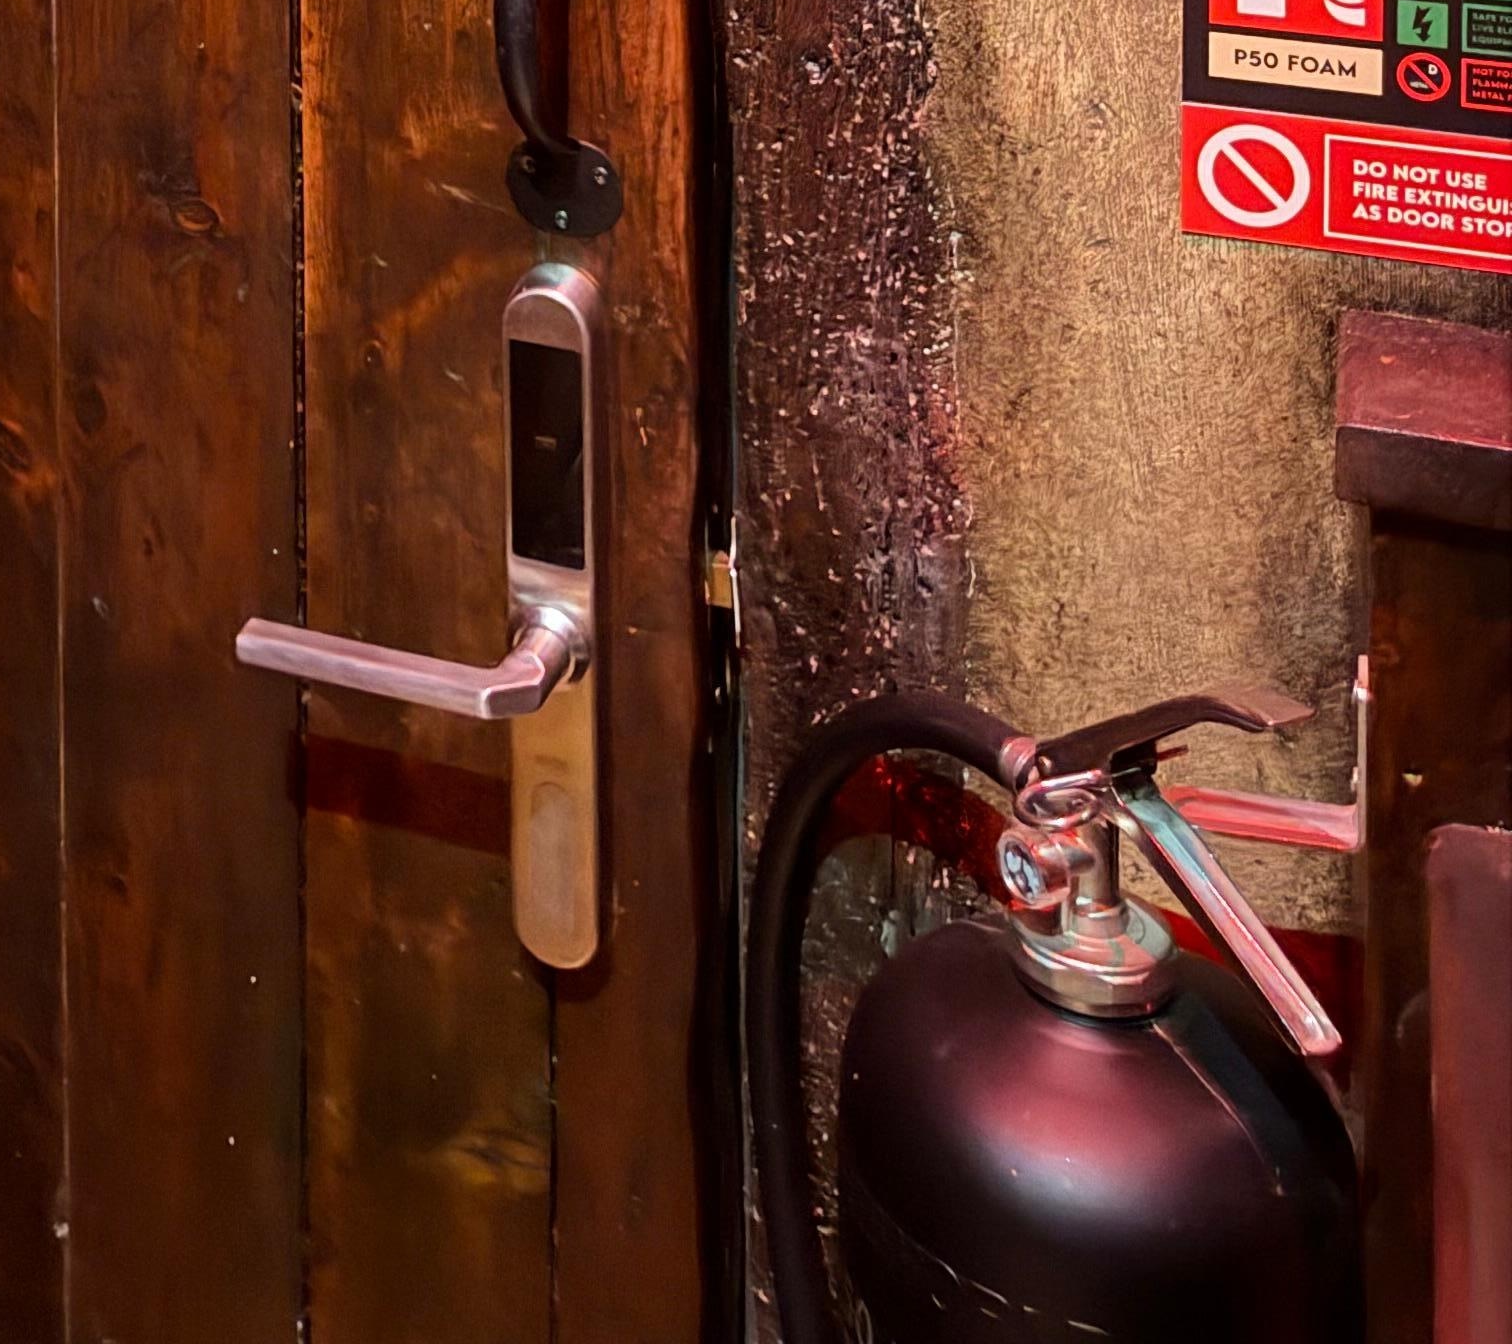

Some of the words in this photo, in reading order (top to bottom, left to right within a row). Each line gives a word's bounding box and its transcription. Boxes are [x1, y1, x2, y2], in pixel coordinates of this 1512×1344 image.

[1234, 48, 1278, 69] P50
[1288, 54, 1357, 78] FOAM
[1428, 63, 1439, 76] D
[1472, 68, 1493, 77] NOT
[1472, 90, 1504, 102] METAL
[1352, 159, 1387, 178] DO
[1392, 164, 1441, 185] NOT
[1445, 170, 1487, 190] USE
[1352, 181, 1399, 202] FIRE
[1352, 202, 1382, 221] AS
[1387, 206, 1455, 231] DOOR
